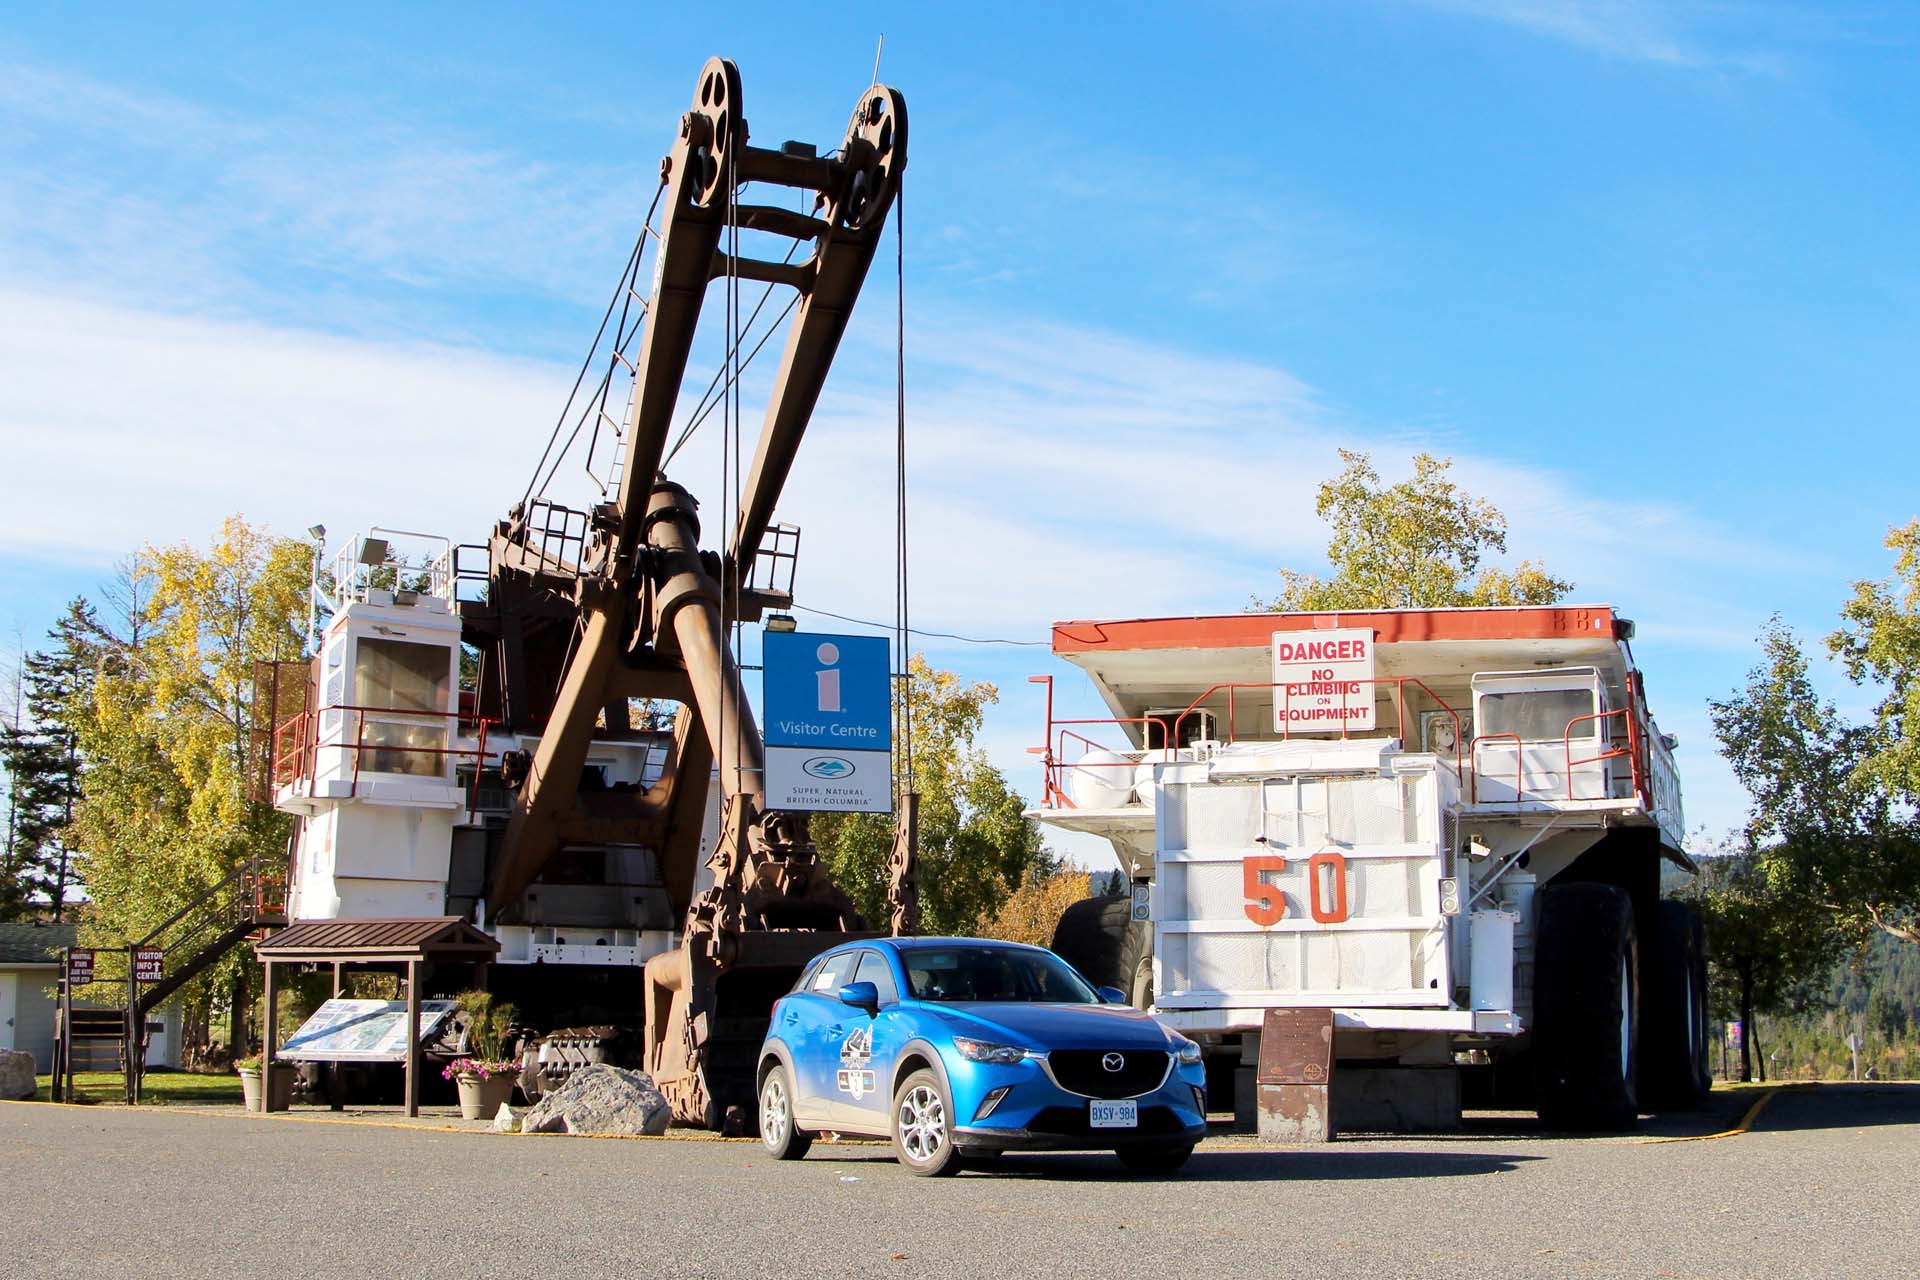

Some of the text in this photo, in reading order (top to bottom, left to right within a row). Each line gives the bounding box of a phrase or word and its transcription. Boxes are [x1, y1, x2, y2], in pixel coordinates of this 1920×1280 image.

[1279, 640, 1365, 661] DANGER
[1311, 669, 1334, 681] NO
[1286, 681, 1361, 696] CLIMBING
[1316, 697, 1331, 705] ON
[1279, 707, 1369, 721] EQUIPMENT
[780, 721, 877, 738] Visitor Centre
[792, 787, 864, 796] SUPER, NATURAL
[786, 796, 869, 806] BRITISH COLUMBIA
[1243, 853, 1347, 926] 50
[138, 952, 163, 960] VISITOR
[136, 962, 152, 970] INFO
[136, 972, 162, 980] CENTRE
